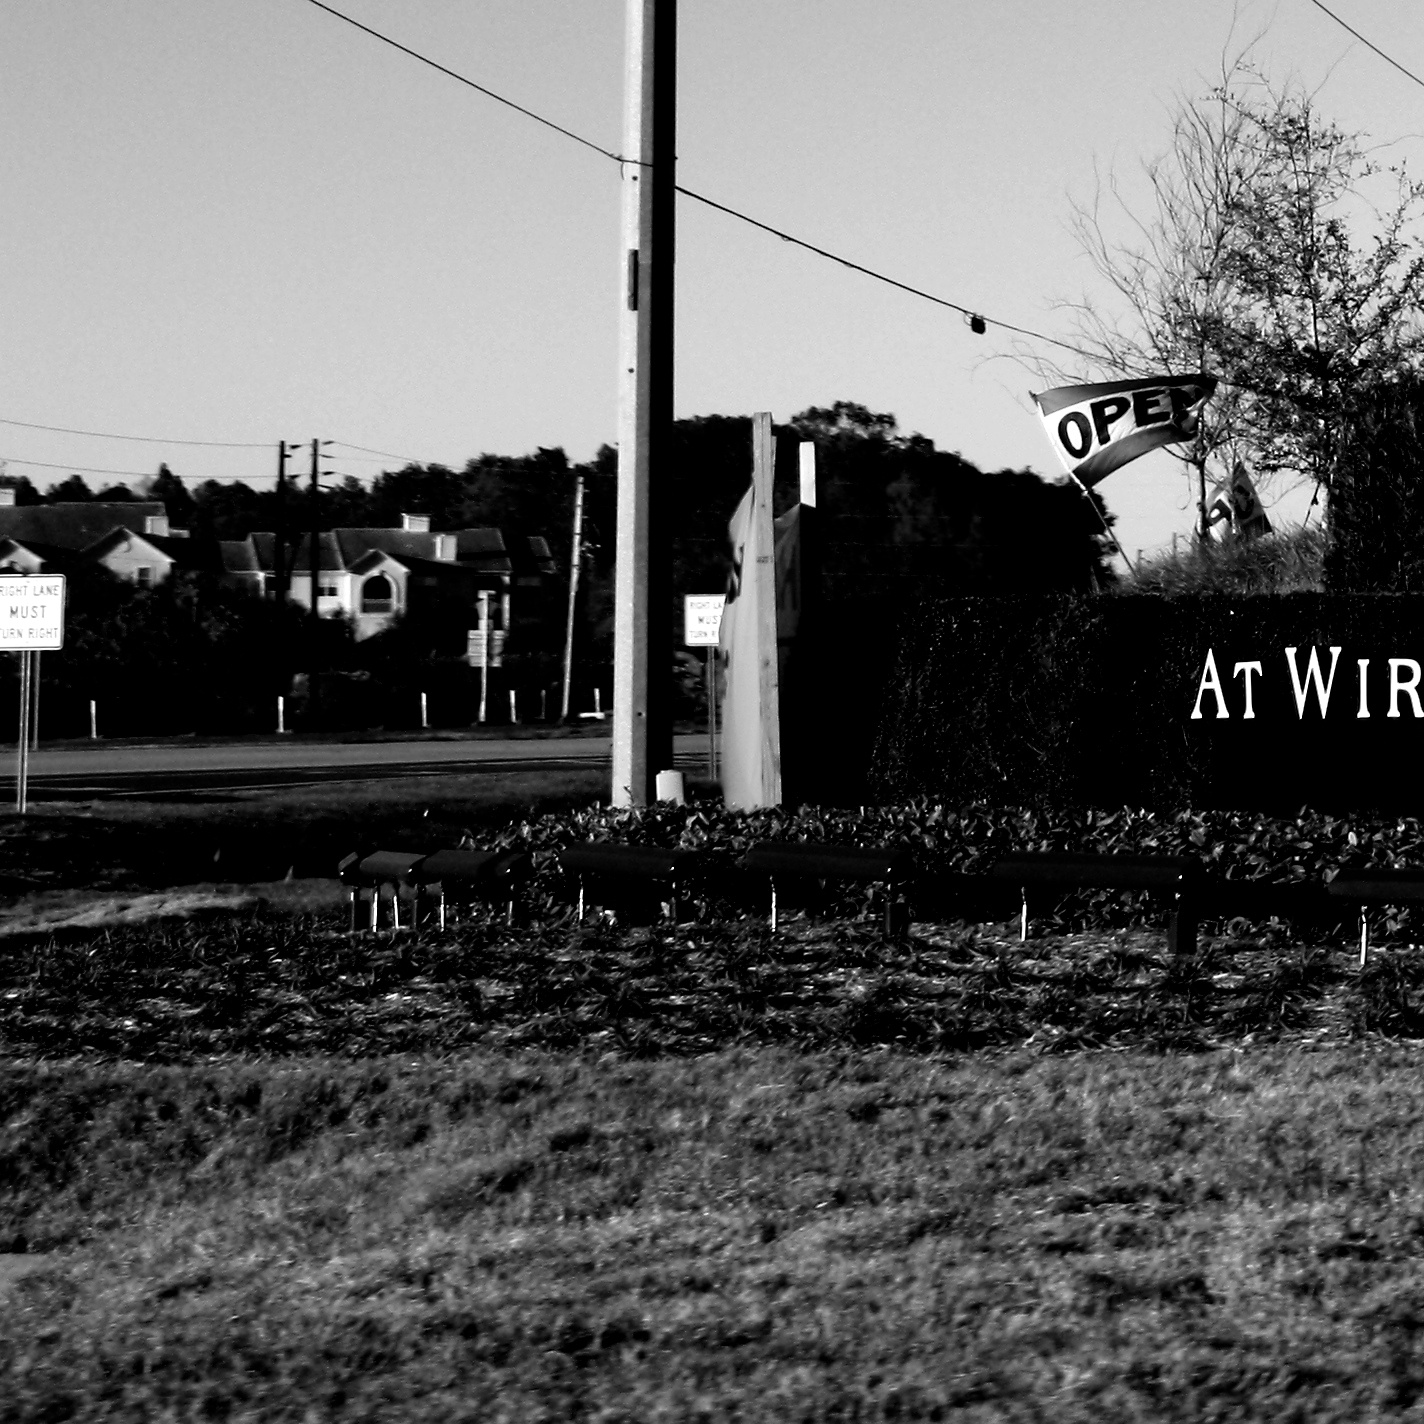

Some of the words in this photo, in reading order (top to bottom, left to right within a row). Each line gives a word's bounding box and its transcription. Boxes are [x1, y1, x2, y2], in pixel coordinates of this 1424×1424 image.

[33, 584, 60, 596] LANE
[9, 605, 47, 619] MUST
[28, 627, 58, 639] RIGHT
[1190, 646, 1264, 720] AT
